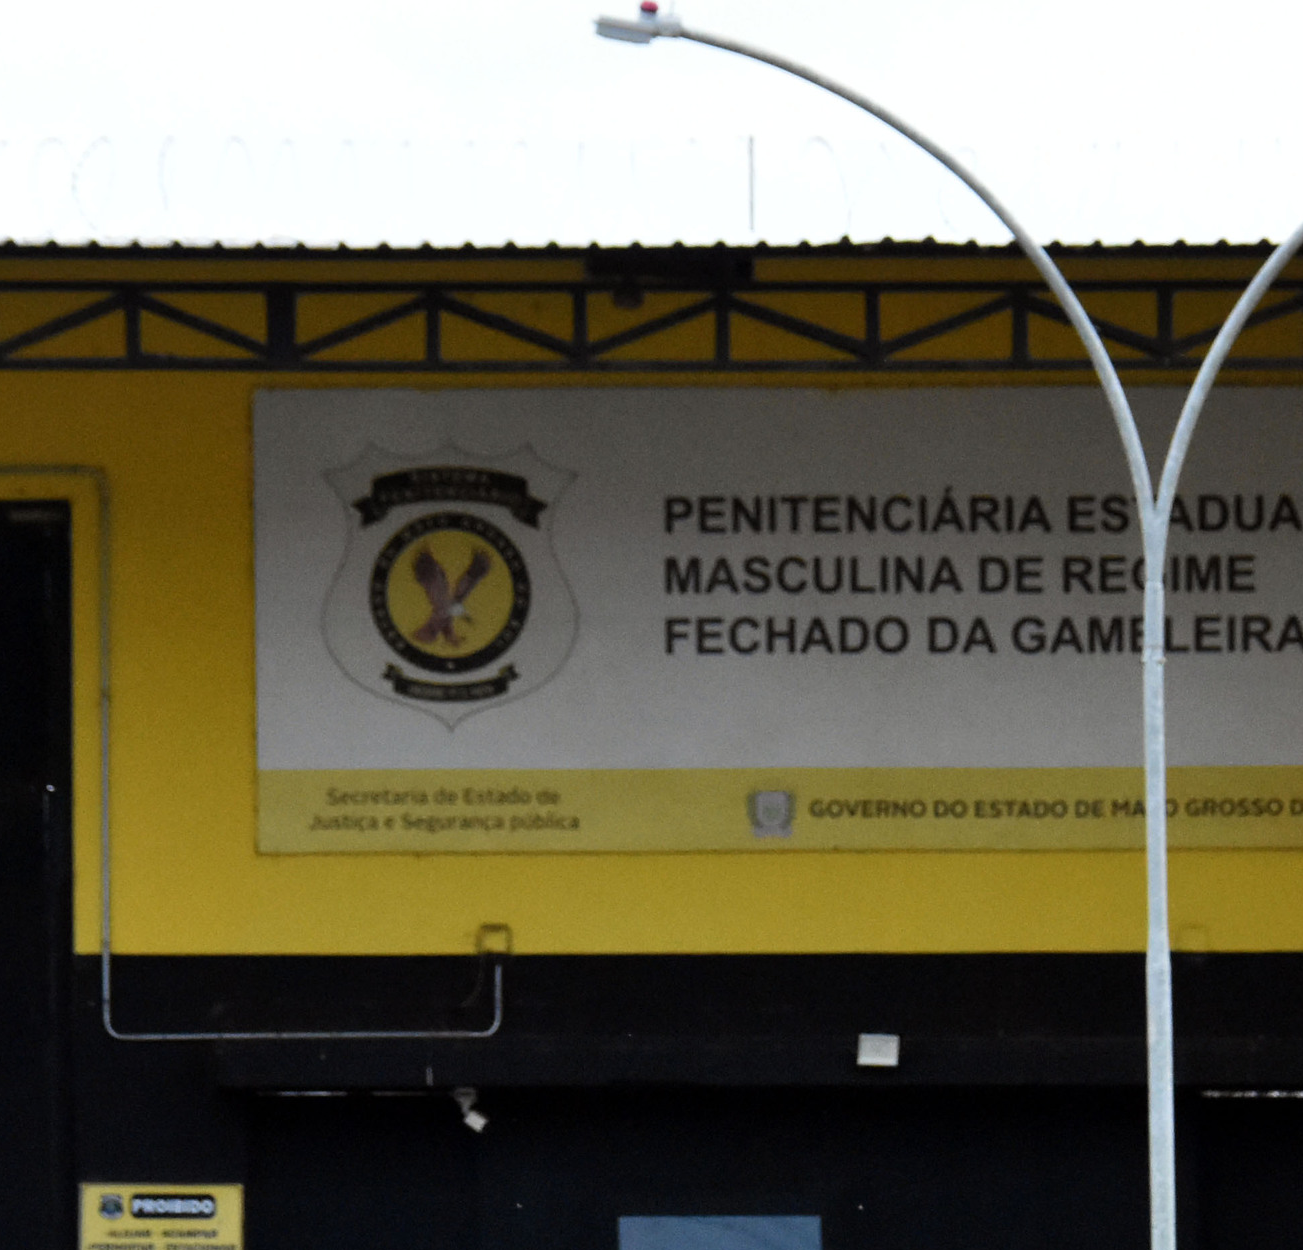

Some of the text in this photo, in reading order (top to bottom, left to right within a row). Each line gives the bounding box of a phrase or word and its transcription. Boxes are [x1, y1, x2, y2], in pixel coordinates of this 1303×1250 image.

[664, 485, 1052, 534] PENITENCIÁRIA
[664, 555, 964, 594] MASCULINA
[978, 555, 1044, 593] DE
[664, 615, 910, 655] FECHADO
[927, 615, 997, 654] DA
[326, 787, 428, 805] Secretaria
[433, 787, 458, 805] de
[461, 787, 532, 805] Estado
[810, 799, 927, 819] GOVERNO
[933, 799, 968, 818] DO
[973, 799, 1068, 818] ESTADO
[1074, 799, 1104, 818] DE
[1111, 798, 1178, 818] MAO
[1184, 798, 1284, 817] GROSSO
